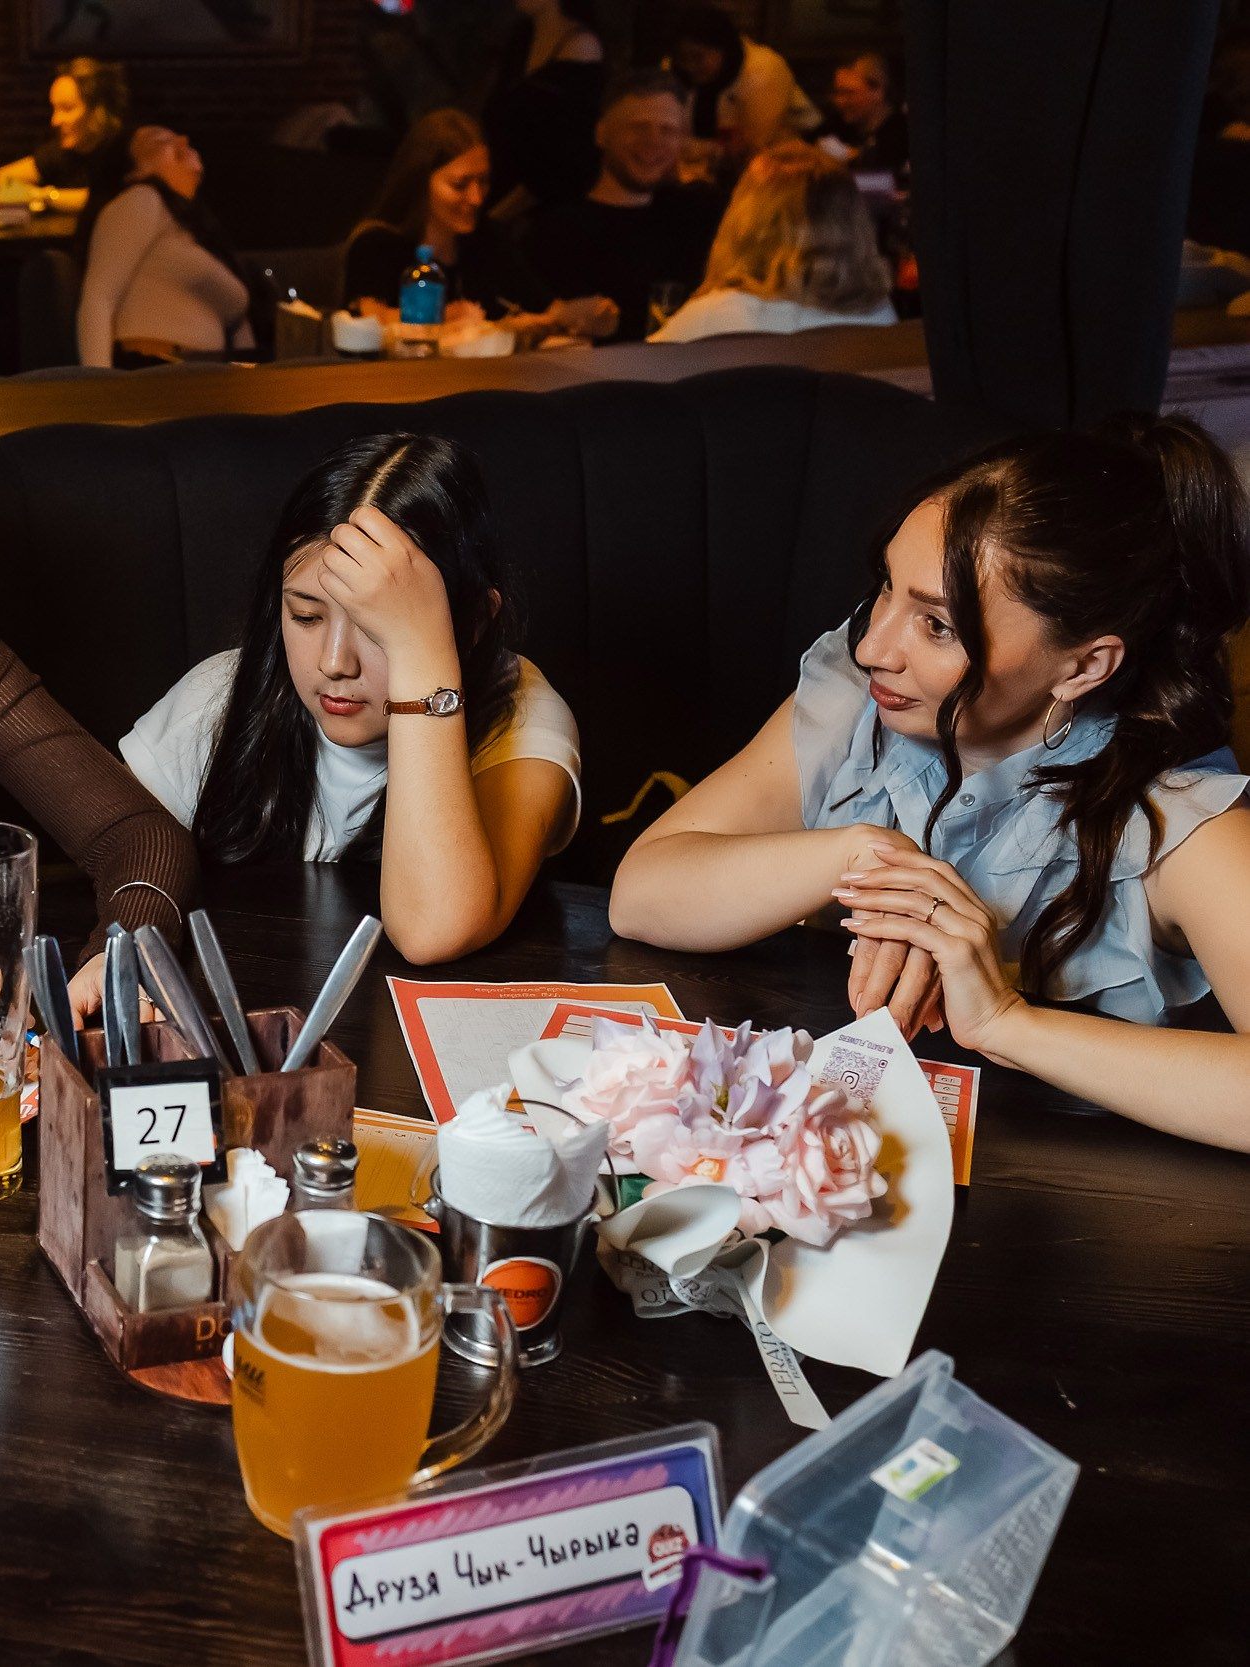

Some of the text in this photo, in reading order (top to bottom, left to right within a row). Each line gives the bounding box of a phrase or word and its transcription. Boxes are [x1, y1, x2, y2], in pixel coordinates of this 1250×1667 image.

[137, 1104, 186, 1145] 27
[756, 1321, 800, 1396] LERATO
[344, 1571, 441, 1614] Друзя
